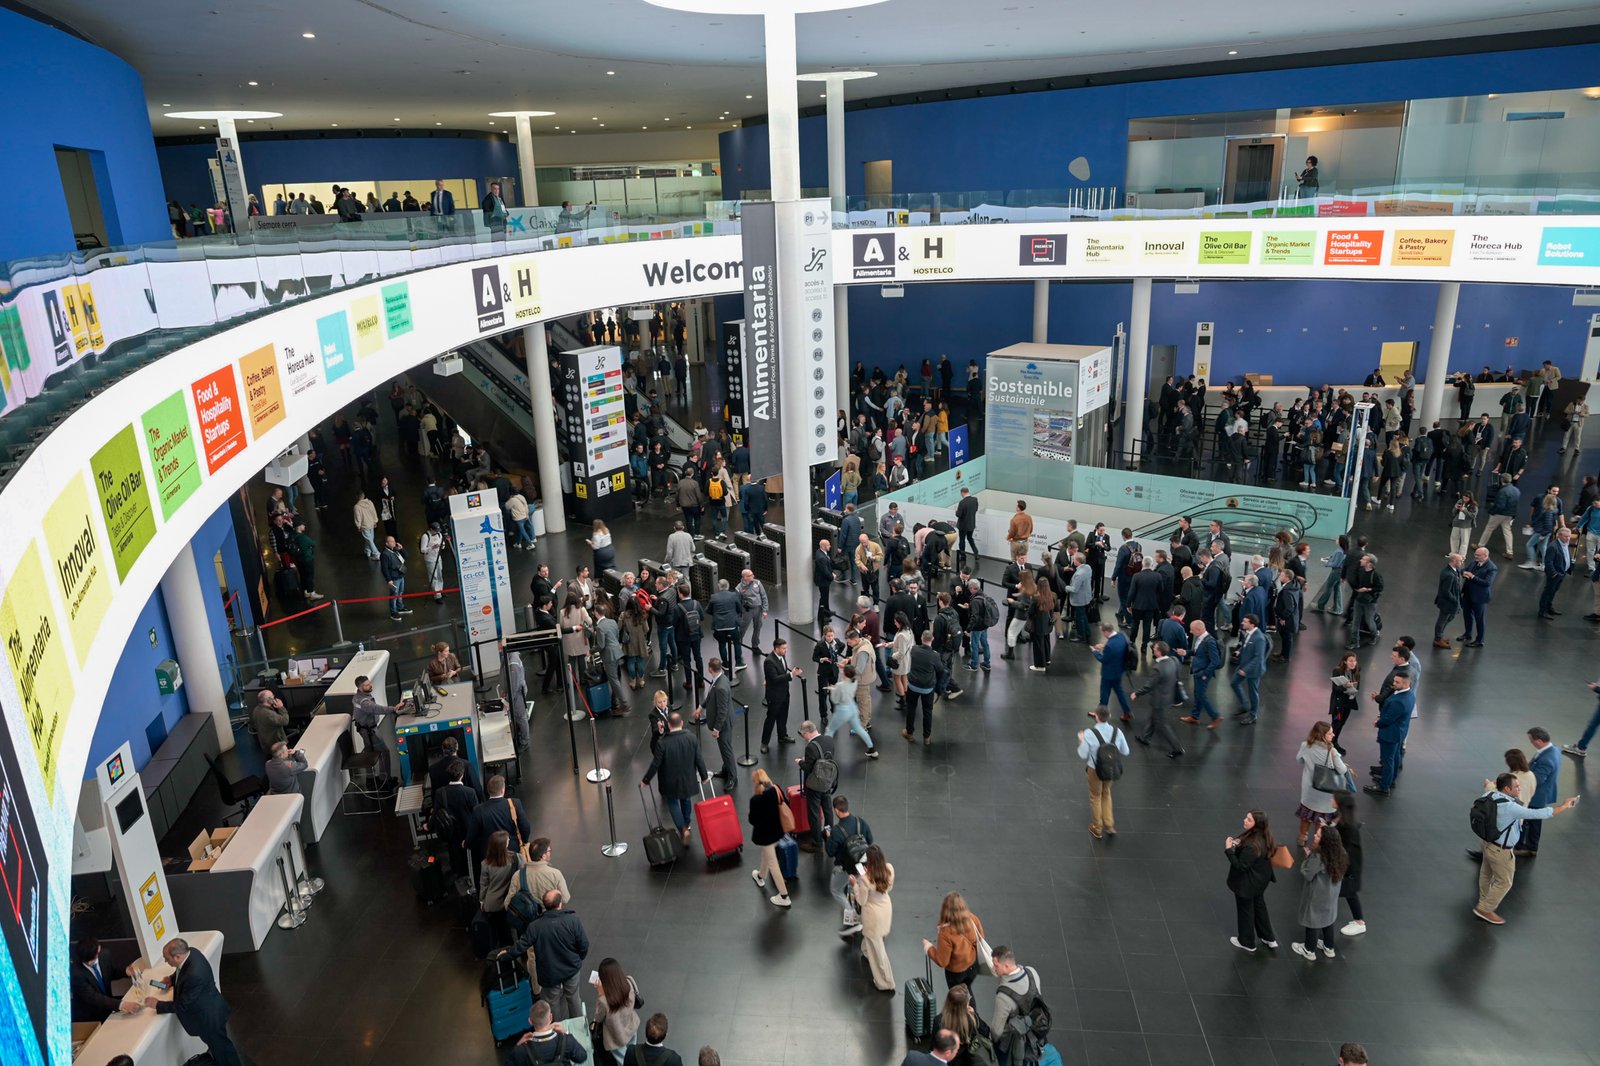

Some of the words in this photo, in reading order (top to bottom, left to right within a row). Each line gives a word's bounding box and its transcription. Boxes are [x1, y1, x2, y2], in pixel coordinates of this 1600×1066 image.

[1145, 241, 1185, 251] Innoval
[1265, 241, 1289, 249] Organic
[1330, 240, 1373, 249] Hospitality
[1424, 237, 1448, 245] Bakery
[1470, 242, 1502, 250] Horeca
[1504, 242, 1523, 250] Hub
[1472, 234, 1489, 242] The
[864, 238, 885, 263] A
[898, 246, 910, 261] &
[924, 237, 943, 259] H
[1329, 247, 1363, 256] Startups
[855, 269, 893, 277] Alimentaria
[913, 267, 954, 275] HOSTELCO
[482, 273, 497, 306] A
[503, 282, 512, 303] &
[517, 268, 533, 298] H
[479, 315, 504, 330] Alimentaria
[515, 306, 541, 319] HOSTELCO
[284, 346, 295, 360] The
[749, 265, 770, 420] Alimentaria
[287, 358, 305, 375] Horeca
[304, 351, 315, 367] Hub
[246, 372, 261, 387] Coffee,
[261, 365, 275, 379] Bakery
[988, 376, 1073, 398] Sostenible
[196, 383, 213, 406] Food
[212, 380, 219, 396] &
[249, 390, 253, 401] &
[253, 385, 266, 399] Pastry
[988, 391, 1046, 406] Sustainable
[200, 396, 232, 425] Hospitality
[148, 427, 160, 444] The
[204, 418, 231, 444] Startups
[153, 436, 173, 462] Organic
[171, 424, 189, 447] Market
[158, 468, 163, 484] &
[161, 456, 180, 479] Trends
[99, 470, 114, 493] The
[601, 481, 606, 490] A
[615, 475, 621, 484] H
[105, 492, 123, 519] Olive
[121, 476, 132, 502] Oil
[129, 470, 142, 492] Bar
[58, 513, 96, 600] Innoval
[9, 628, 23, 670] The
[20, 615, 51, 713] Alimentaria
[31, 697, 44, 750] Hub
